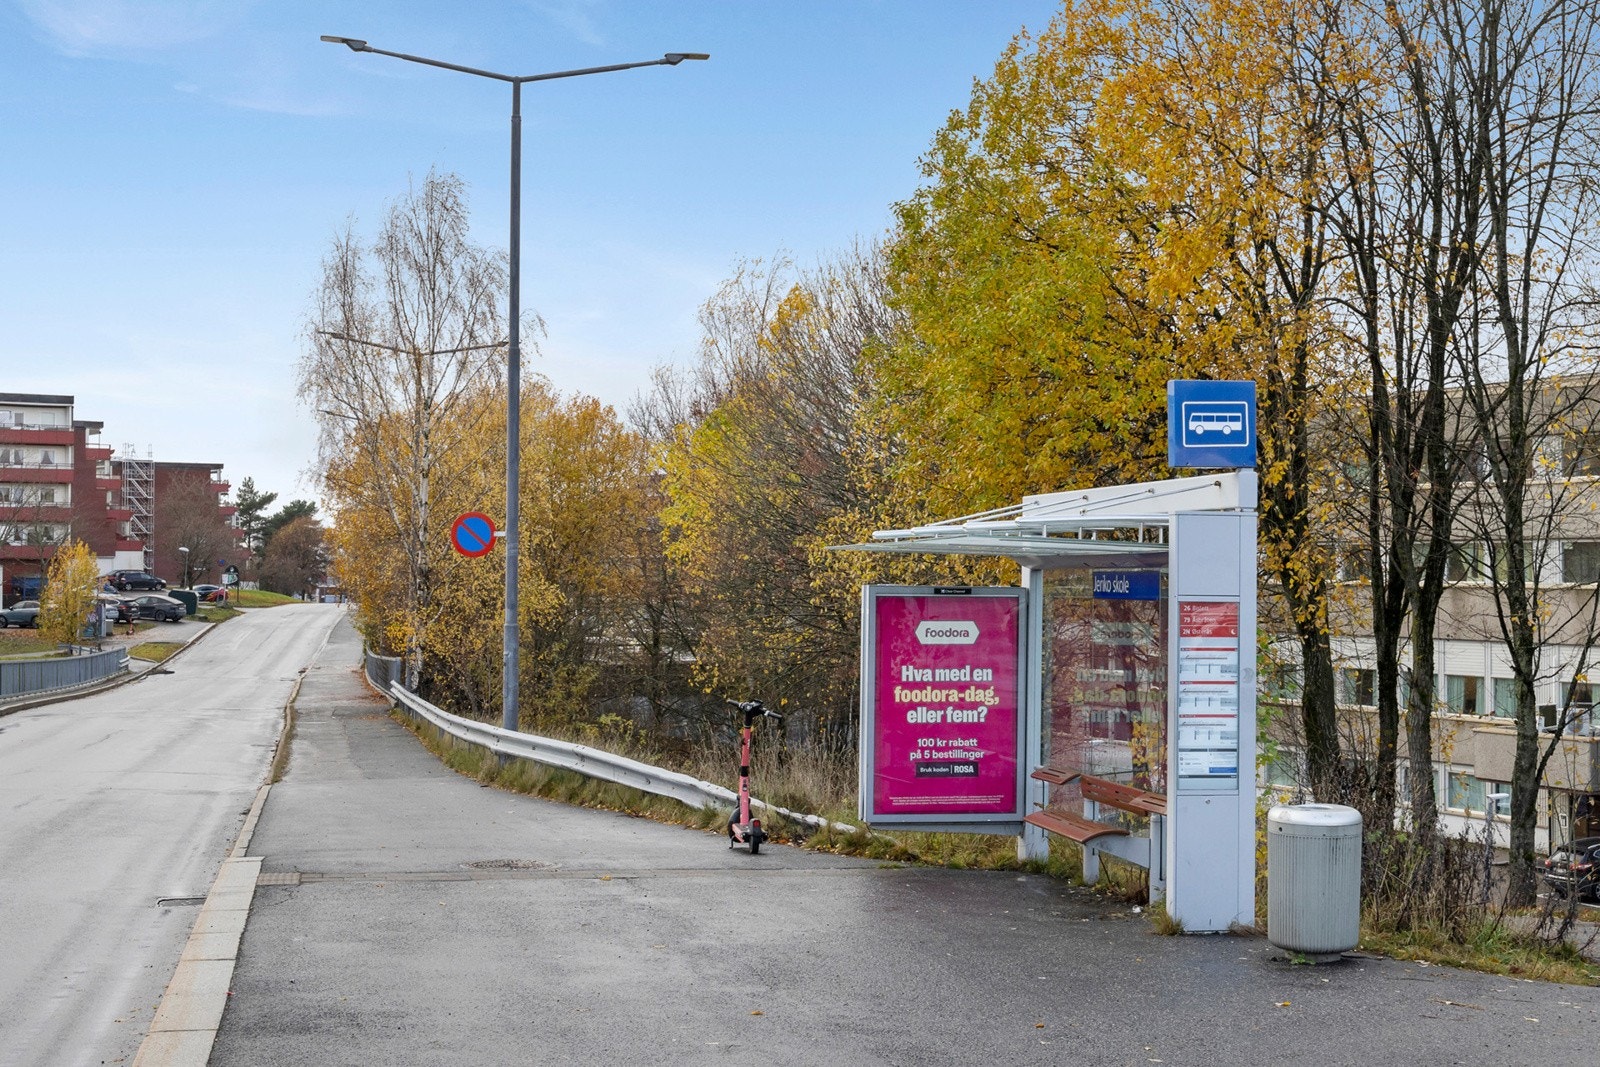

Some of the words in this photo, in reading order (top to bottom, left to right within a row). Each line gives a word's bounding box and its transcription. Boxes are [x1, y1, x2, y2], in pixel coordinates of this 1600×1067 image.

[1113, 575, 1129, 593] skole
[925, 628, 969, 638] foodora
[901, 665, 932, 682] Hva
[935, 665, 970, 682] med
[973, 668, 992, 682] en
[894, 686, 1000, 705] foodora-dag,
[906, 707, 944, 723] eller
[946, 706, 988, 723] fem?
[917, 738, 934, 747] 100
[937, 738, 947, 746] kr
[949, 738, 978, 746] rabatt
[910, 749, 921, 760] på
[924, 750, 930, 759] 5
[932, 749, 984, 760] bestillinger
